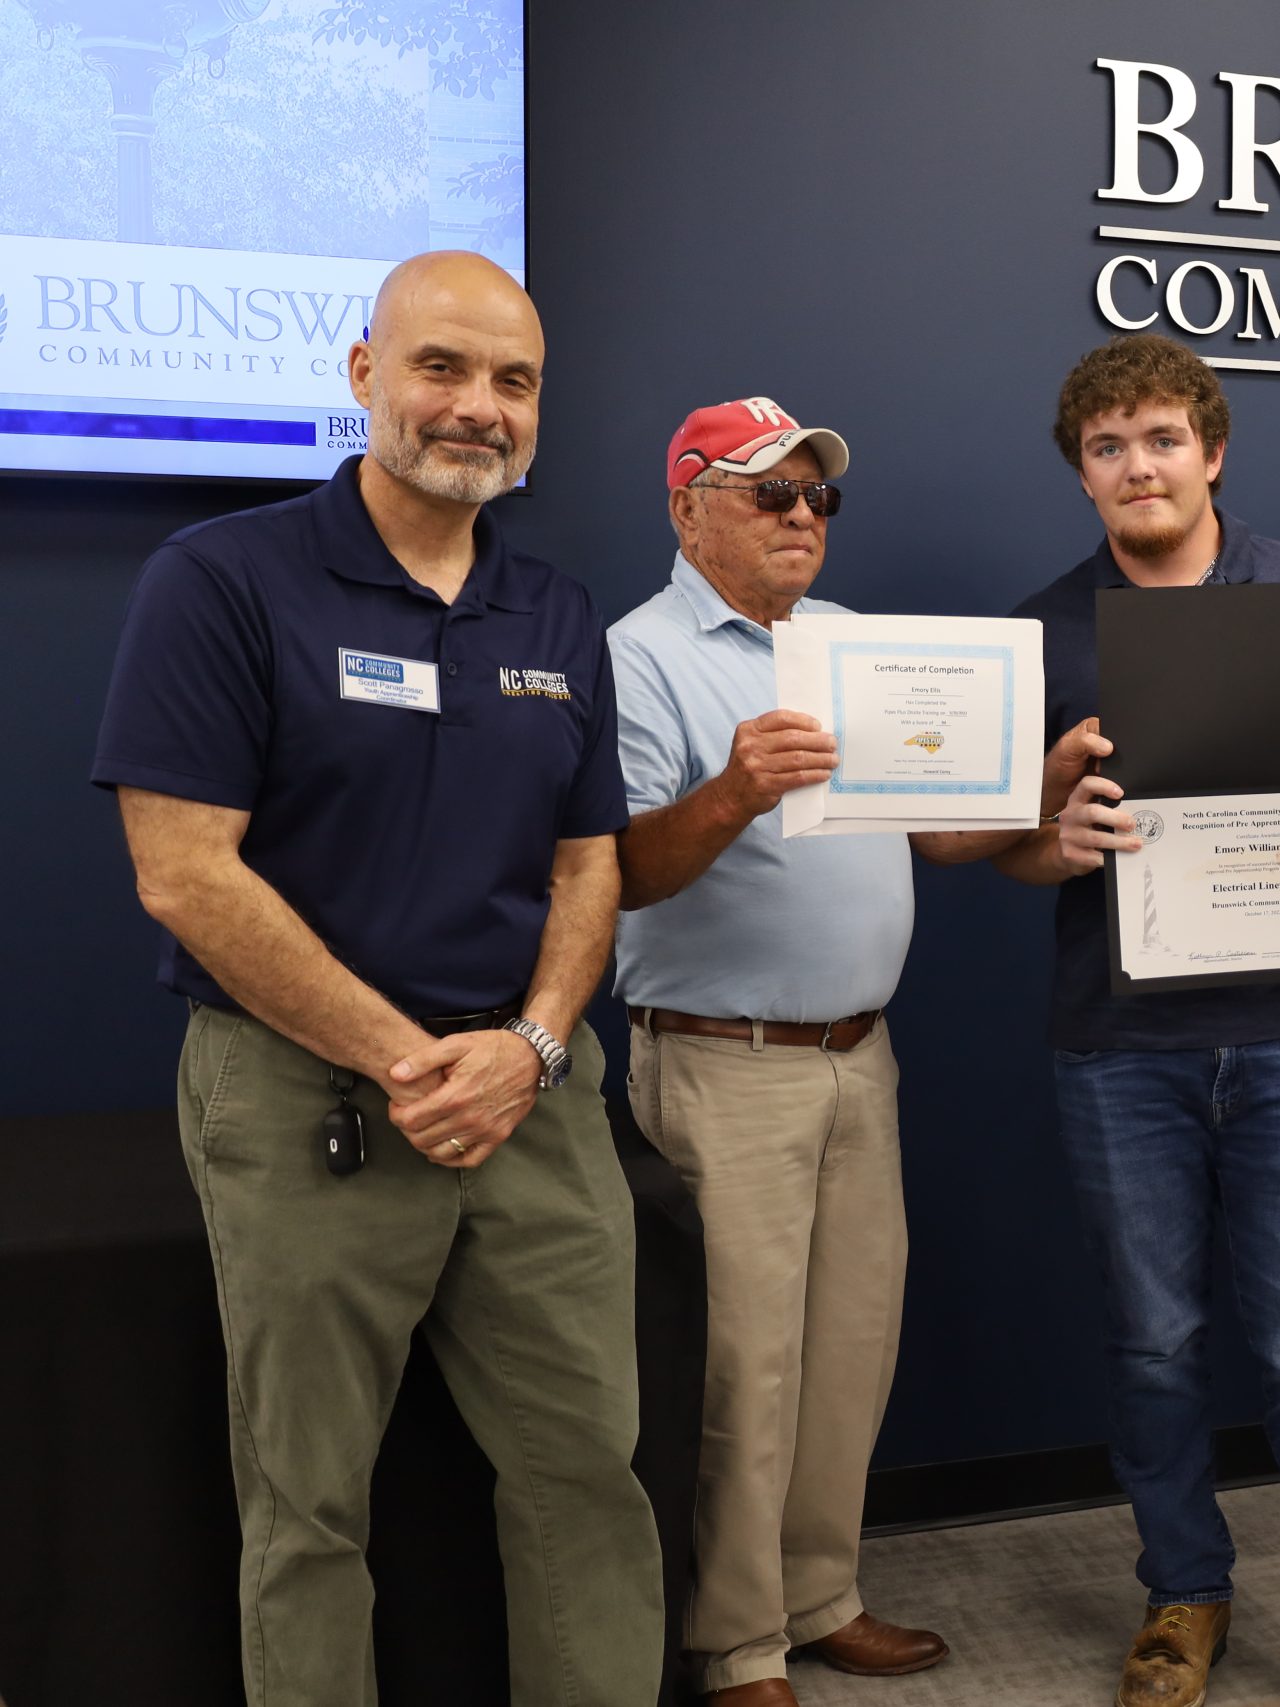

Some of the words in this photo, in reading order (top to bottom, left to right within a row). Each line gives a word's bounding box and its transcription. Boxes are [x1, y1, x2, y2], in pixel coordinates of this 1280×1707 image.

[34, 275, 373, 346] BRUNSWI
[39, 344, 285, 375] COMMUNITY
[327, 416, 368, 437] BRU
[327, 440, 367, 449] COMM
[347, 656, 364, 672] NC
[364, 659, 400, 670] COMMUNITY
[874, 664, 916, 673] Certificate
[918, 665, 927, 673] of
[928, 666, 974, 675] Completion
[365, 666, 400, 678] COLLEGES
[522, 669, 566, 683] COMMUNITY
[358, 678, 378, 688] Scott
[500, 666, 522, 690] NC
[525, 678, 569, 693] COLLEGES
[911, 686, 929, 694] Emory
[1182, 811, 1203, 819] North
[1206, 810, 1238, 818] Carolina
[1182, 822, 1225, 830] Recognition
[1236, 820, 1248, 828] Pre
[1214, 845, 1246, 854] Emory
[1213, 883, 1256, 893] Electrical
[1212, 900, 1247, 909] Brunswick
